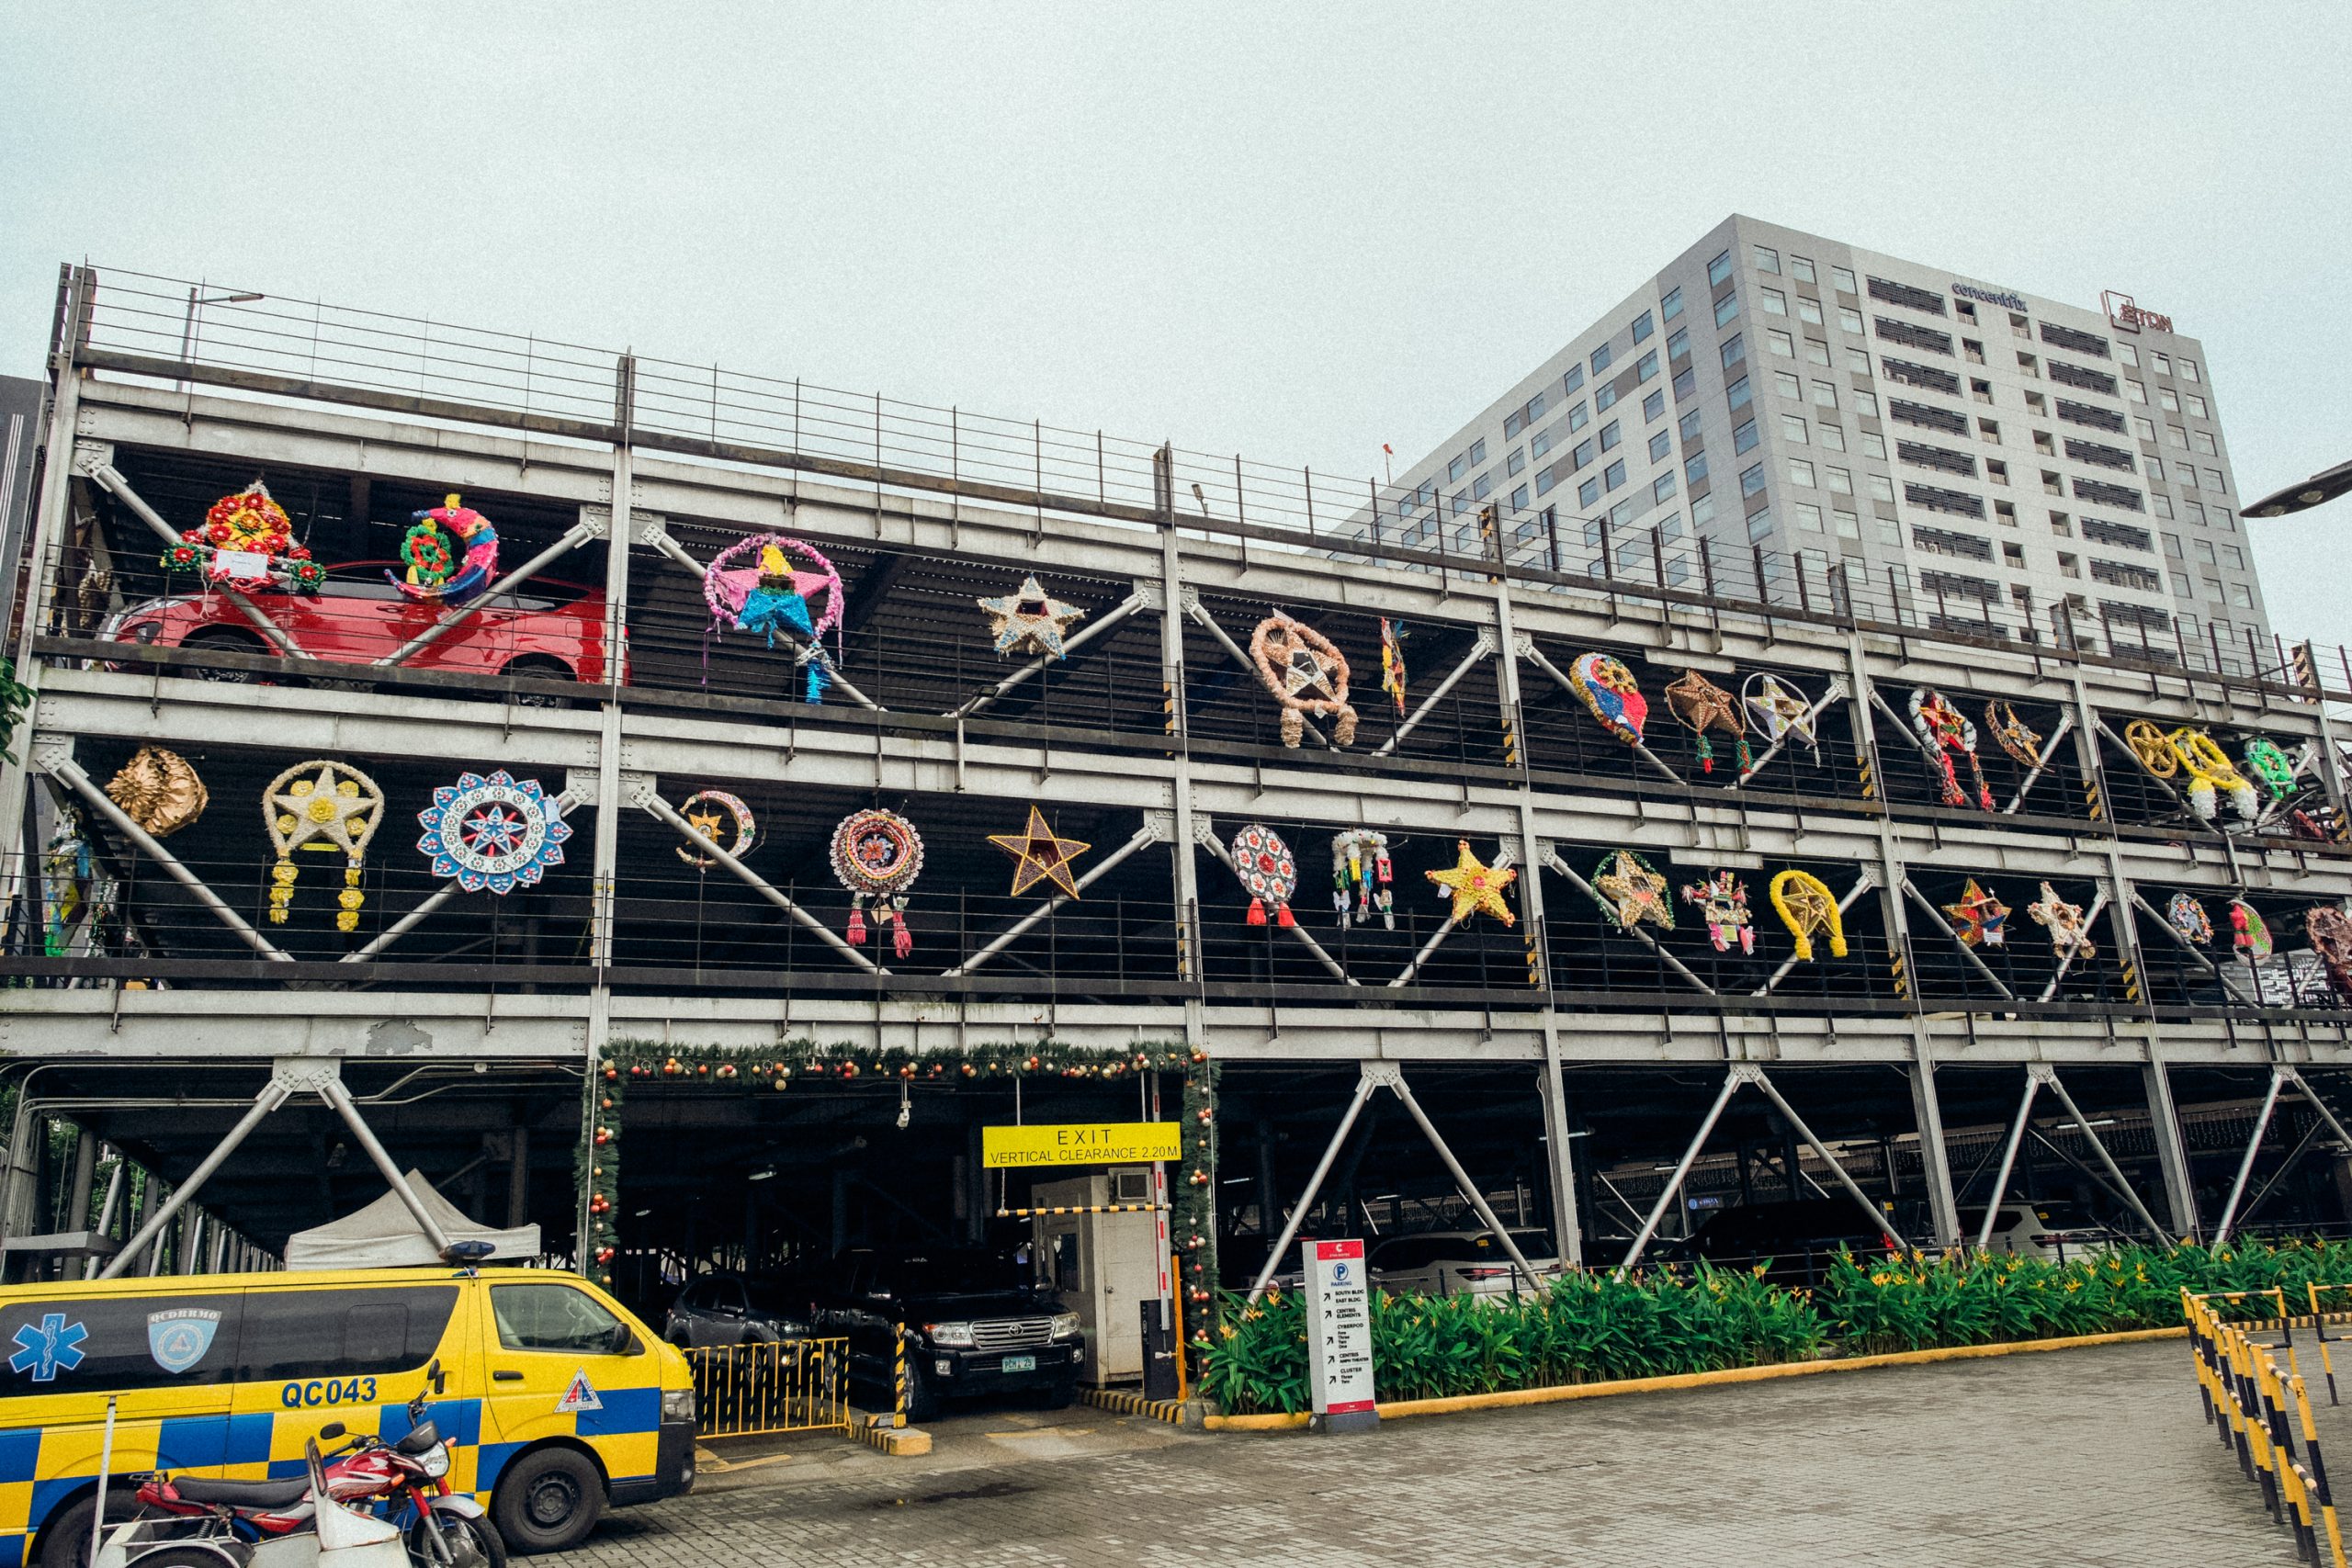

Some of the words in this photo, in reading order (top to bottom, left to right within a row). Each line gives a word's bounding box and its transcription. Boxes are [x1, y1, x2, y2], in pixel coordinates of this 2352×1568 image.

[1951, 283, 2029, 312] concentrix
[1057, 1129, 1112, 1145] EXIT
[990, 1150, 1054, 1164] VERTICAL
[1059, 1147, 1136, 1161] CLEARANCE
[281, 1377, 377, 1409] QC043
